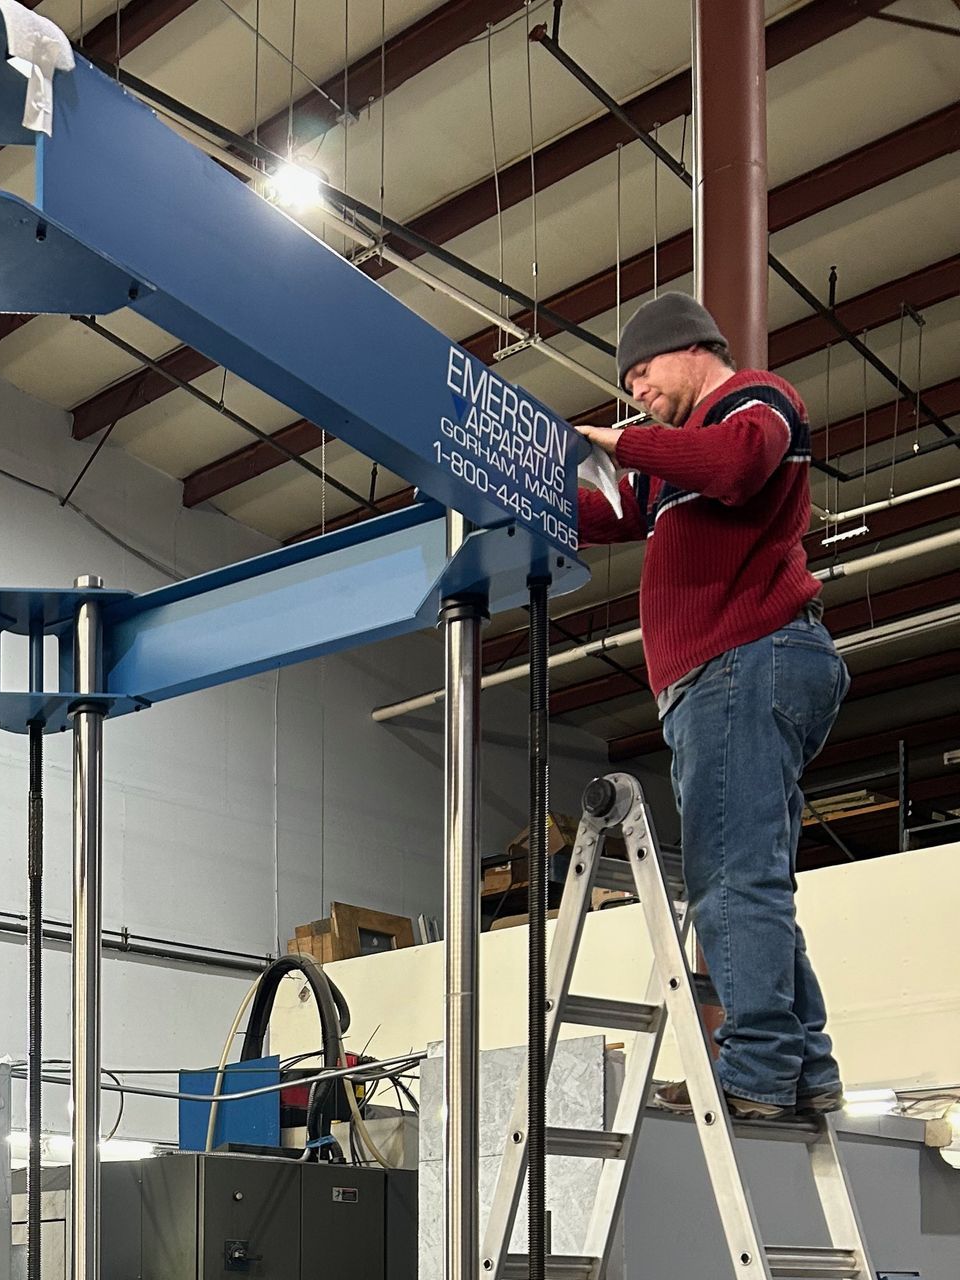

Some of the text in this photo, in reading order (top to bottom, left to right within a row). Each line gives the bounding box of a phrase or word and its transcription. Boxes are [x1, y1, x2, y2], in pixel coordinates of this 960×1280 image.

[447, 346, 568, 466] EMERSON
[465, 406, 566, 493] APPARATUS
[433, 441, 579, 551] 1-800-445-1055
[525, 476, 573, 519] MAINE
